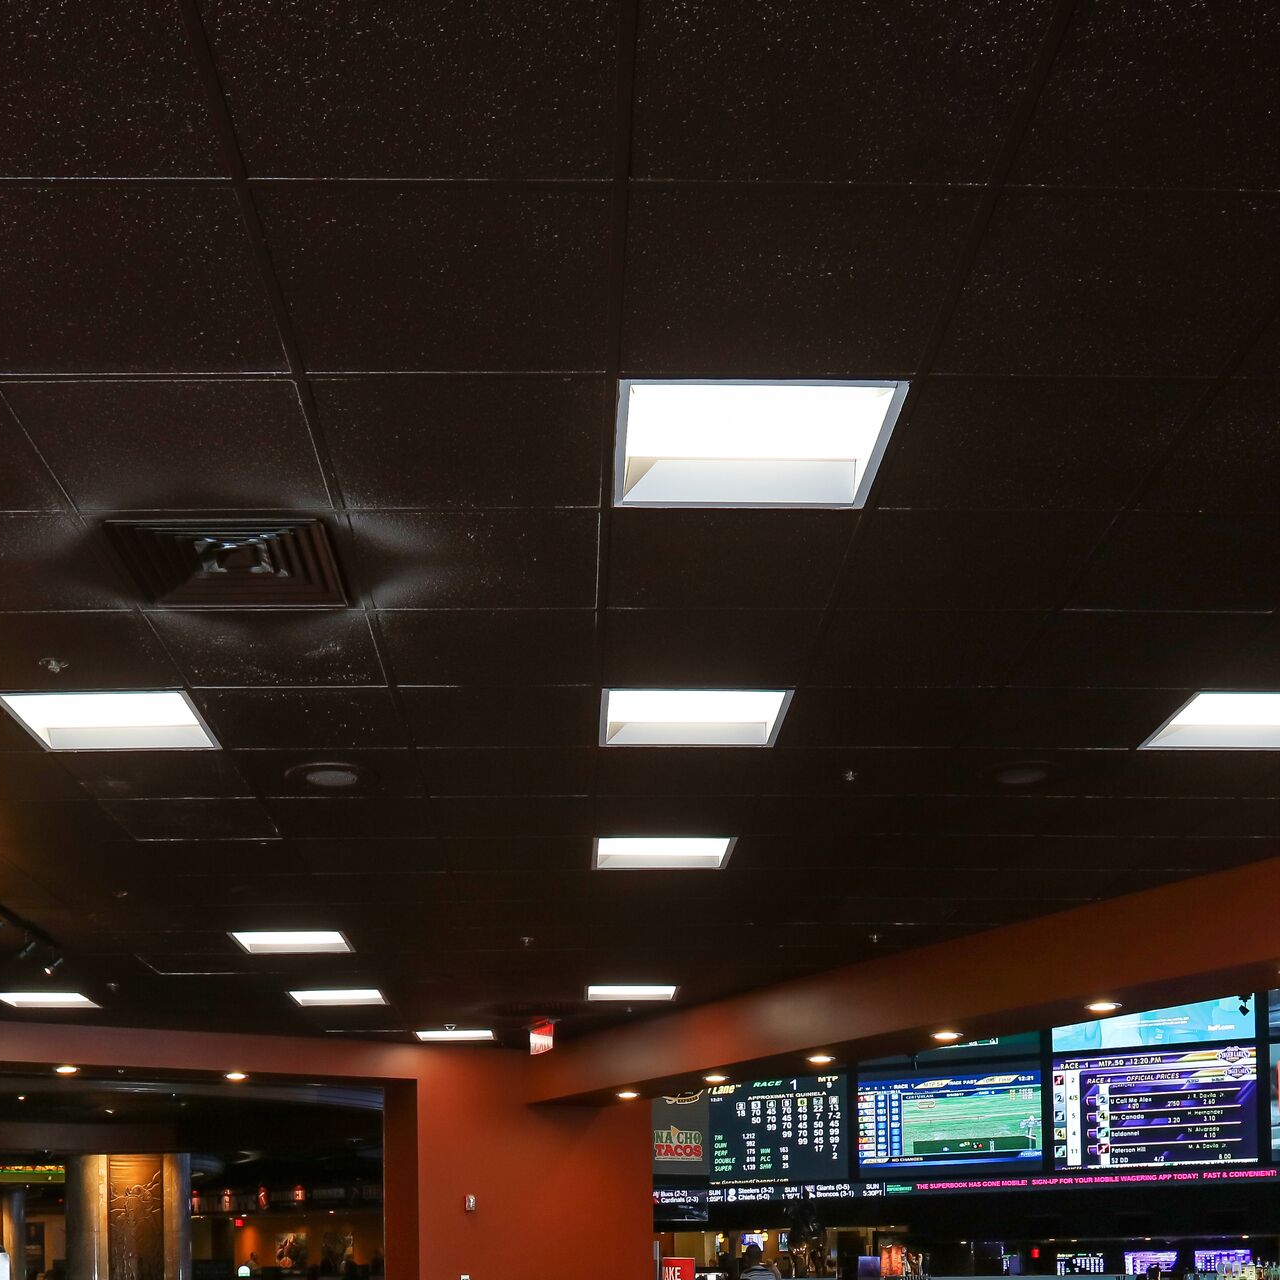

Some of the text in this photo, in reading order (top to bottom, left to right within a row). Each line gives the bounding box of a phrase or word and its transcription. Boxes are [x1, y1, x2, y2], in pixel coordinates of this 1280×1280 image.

[817, 1075, 839, 1083] MTP
[1126, 1074, 1154, 1082] OFFICIAL
[753, 1079, 798, 1091] RACE 1
[826, 1081, 832, 1089] 9
[747, 1093, 794, 1101] APPROXIMATE
[655, 1131, 702, 1145] NACHO
[655, 1144, 702, 1157] TACOS
[929, 1182, 967, 1190] SUPERBOOK
[968, 1181, 981, 1189] HAS
[982, 1180, 1000, 1188] GONE
[1002, 1179, 1028, 1187] MOBILE!
[1032, 1178, 1058, 1186] SIGN-UP
[1094, 1175, 1119, 1183] MOBILE
[1120, 1174, 1157, 1182] WAGERING
[1158, 1173, 1171, 1181] APP
[1173, 1172, 1198, 1180] TODAY!
[1203, 1171, 1221, 1179] FAST
[1229, 1170, 1277, 1178] CONVENIENT!
[685, 1196, 699, 1204] (2-3)
